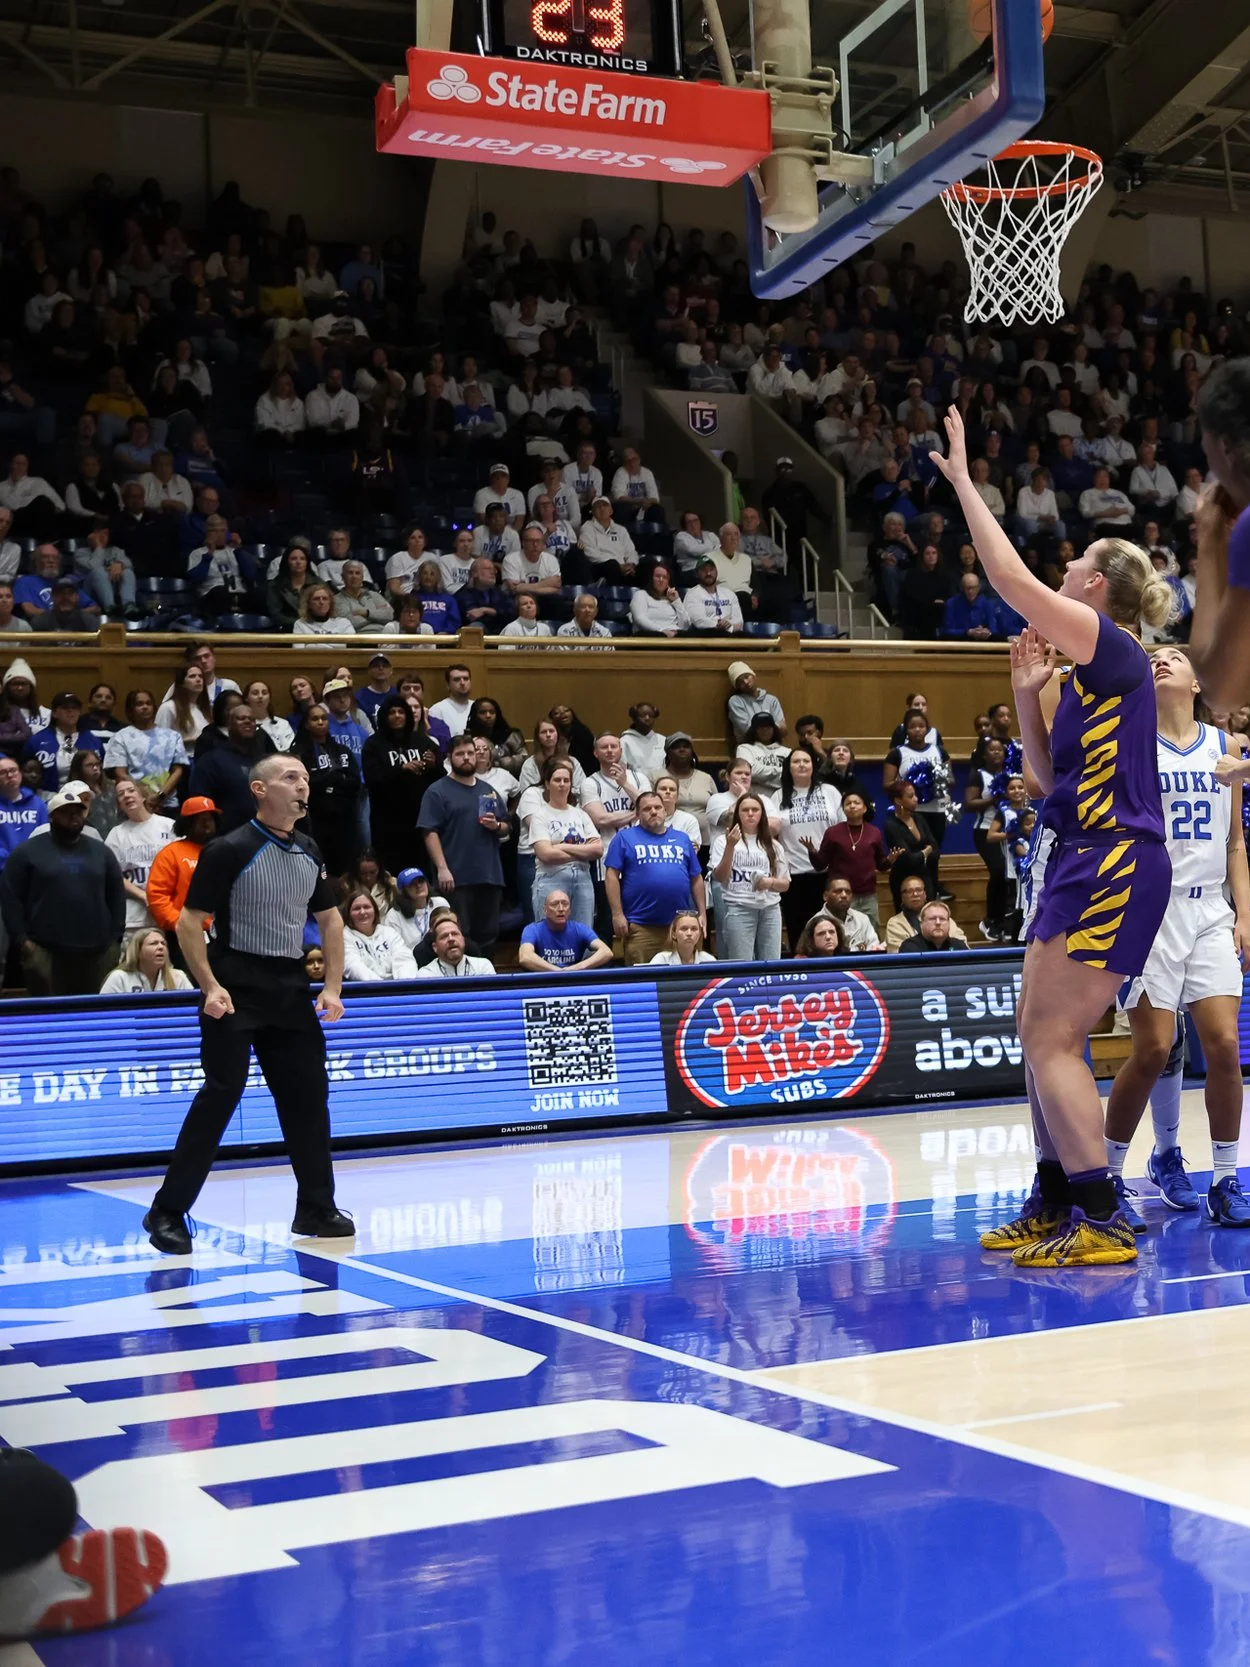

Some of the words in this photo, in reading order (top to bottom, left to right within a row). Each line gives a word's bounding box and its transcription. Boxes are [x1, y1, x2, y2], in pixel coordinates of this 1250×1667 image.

[517, 46, 648, 71] DAKTRONICS
[694, 410, 714, 430] 15
[1159, 771, 1221, 794] DUKE
[1171, 800, 1212, 841] 22
[634, 844, 684, 859] DUKE
[738, 976, 773, 995] SINCE
[705, 987, 857, 1047] Jersey
[922, 989, 949, 1022] a
[33, 1068, 108, 1104] DAY
[119, 1064, 160, 1097] IN
[363, 1044, 497, 1079] GROUPS
[530, 1092, 574, 1112] JOIN
[578, 1089, 620, 1109] NOW
[770, 1078, 828, 1104] SUBS
[501, 1124, 549, 1133] DAKTRONICS
